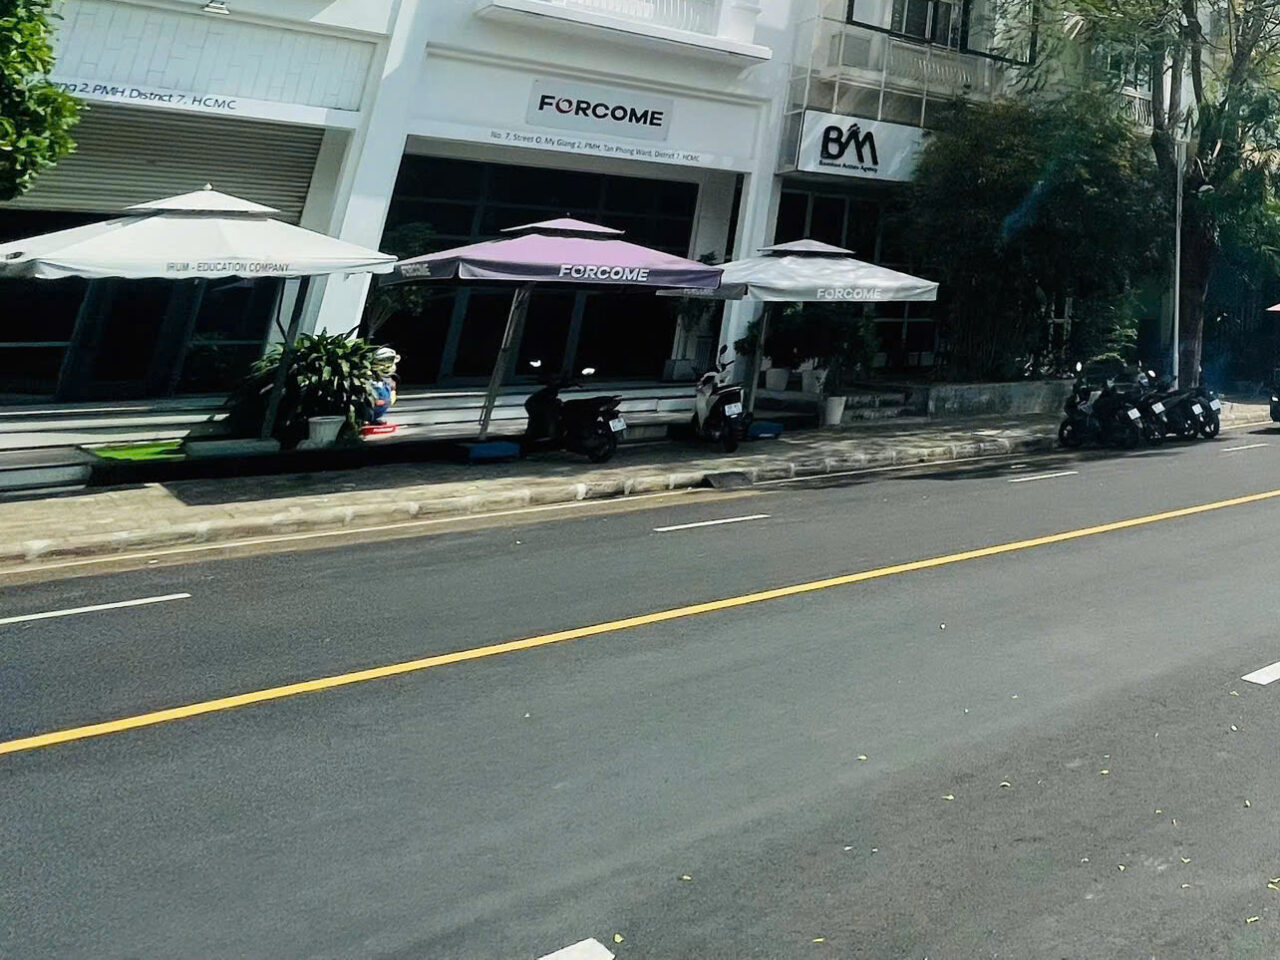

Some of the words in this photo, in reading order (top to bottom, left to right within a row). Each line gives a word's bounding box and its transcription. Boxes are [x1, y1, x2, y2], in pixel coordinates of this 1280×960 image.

[129, 89, 173, 102] District
[192, 96, 237, 110] HCMC
[538, 94, 664, 127] FORCOME
[197, 262, 247, 273] EDUCATION
[248, 262, 290, 273] COMPANY
[559, 264, 649, 282] FORCOME
[816, 288, 882, 300] FORCOME
